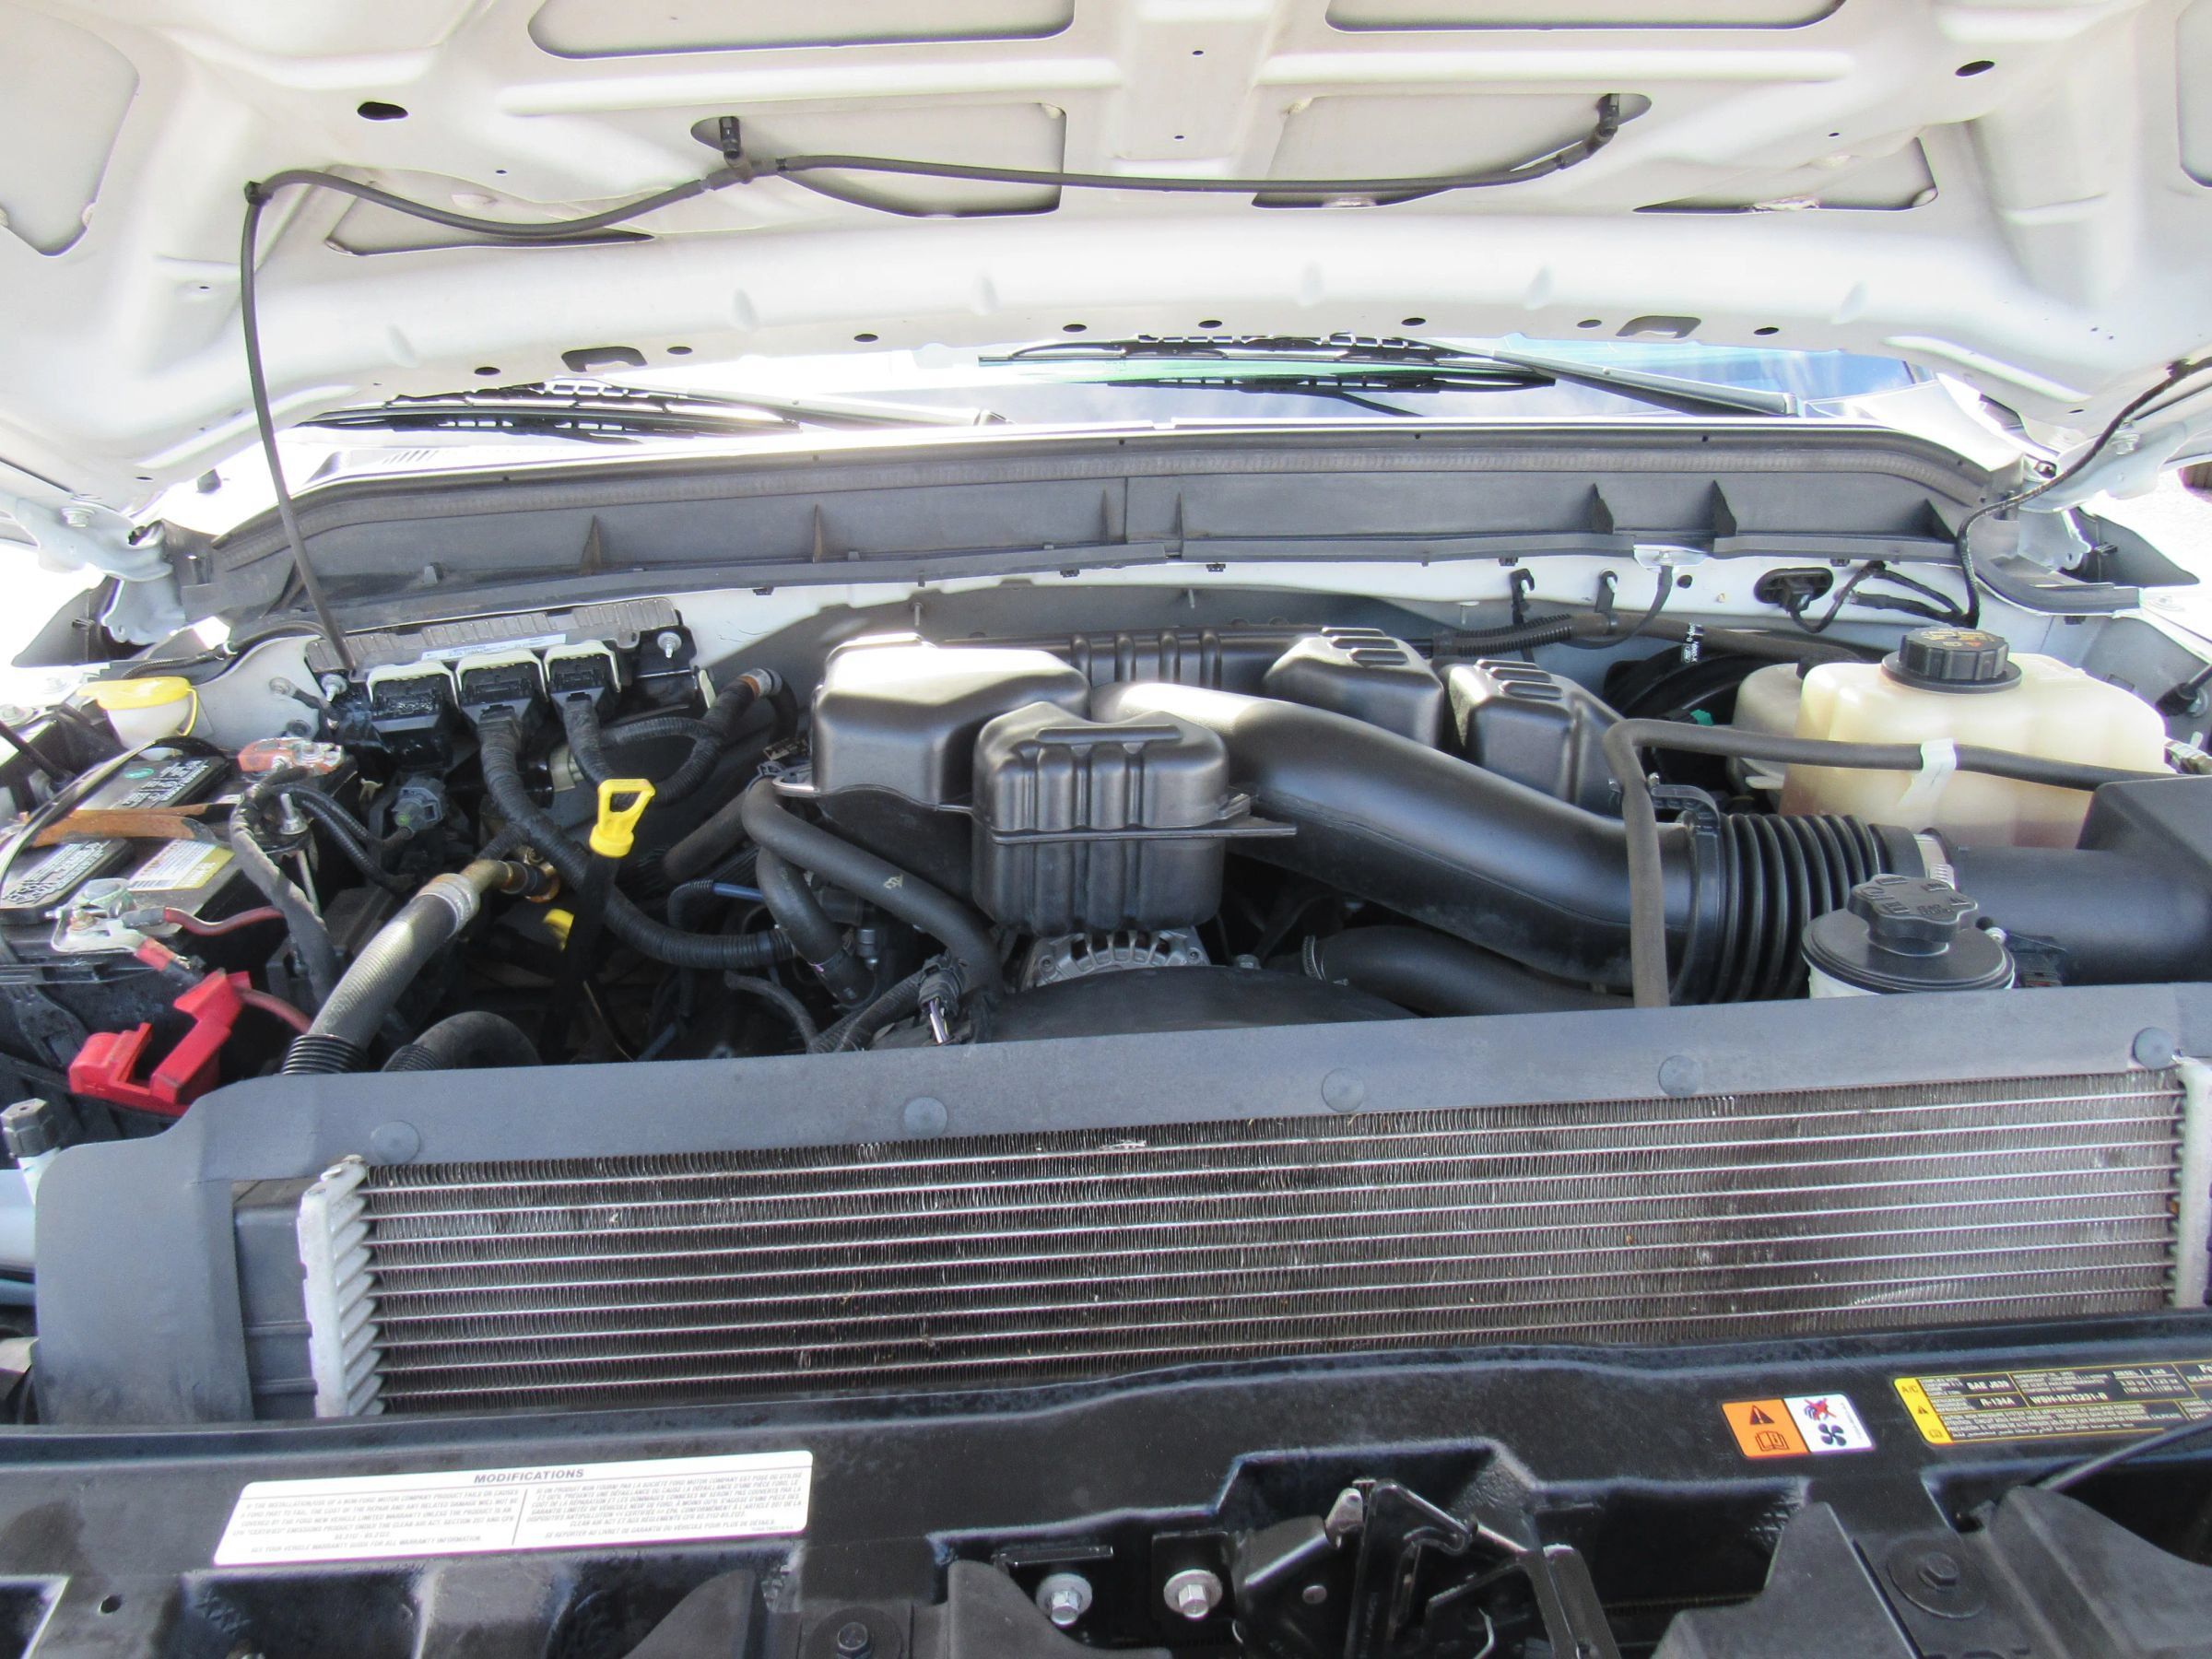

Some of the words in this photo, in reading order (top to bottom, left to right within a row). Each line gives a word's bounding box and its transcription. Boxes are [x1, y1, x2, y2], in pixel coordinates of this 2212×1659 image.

[1901, 1384, 1920, 1394] A/C
[1967, 1381, 1989, 1390] SAE
[474, 1469, 584, 1483] MODIFICATIONS
